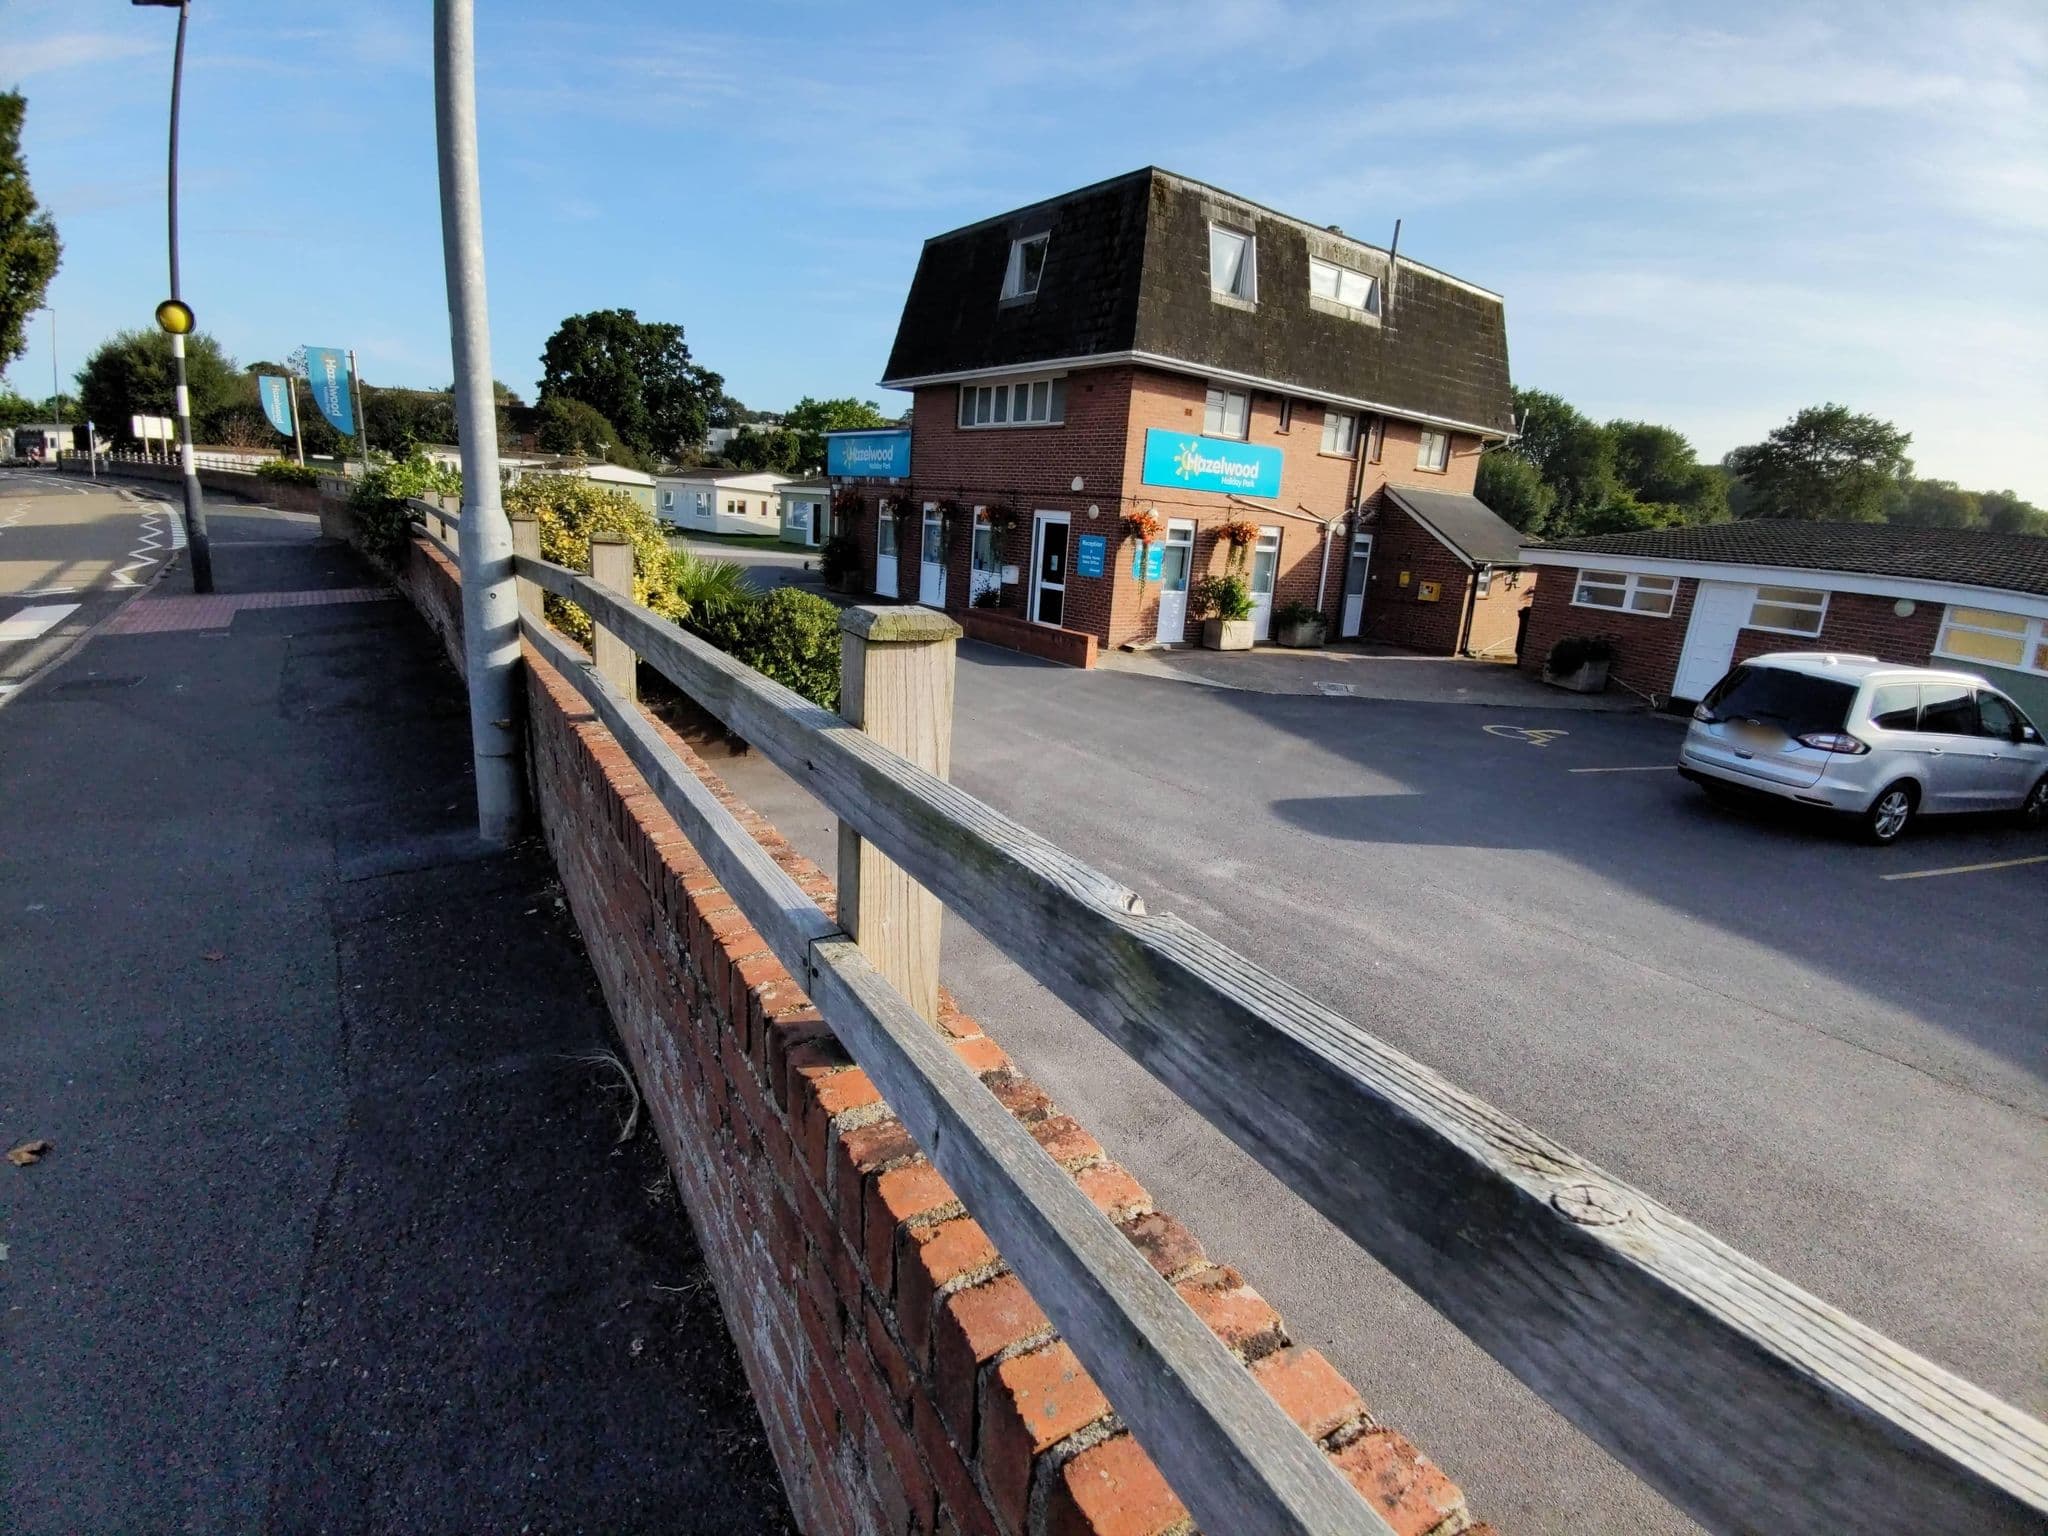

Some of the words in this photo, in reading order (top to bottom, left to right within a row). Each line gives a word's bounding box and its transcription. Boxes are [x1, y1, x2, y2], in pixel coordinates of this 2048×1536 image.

[325, 359, 343, 417] Hazelwood
[846, 445, 894, 462] Hazelwood
[1186, 451, 1260, 480] Hazelwood
[1221, 476, 1242, 487] Holiday
[1242, 478, 1255, 488] Park
